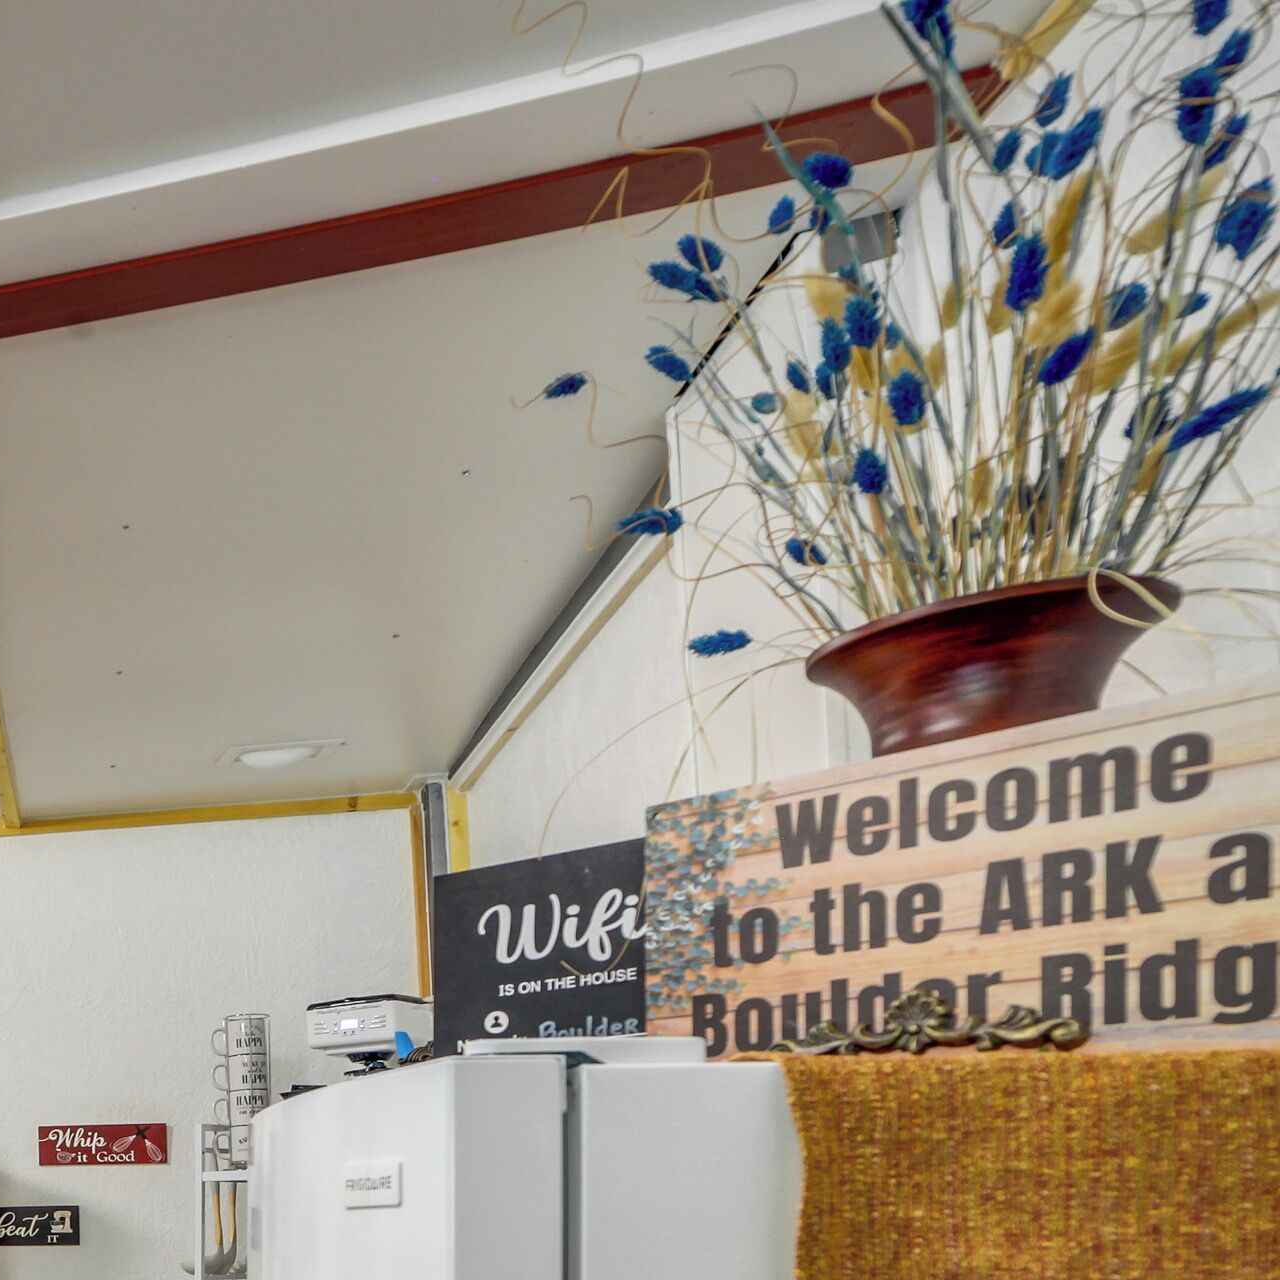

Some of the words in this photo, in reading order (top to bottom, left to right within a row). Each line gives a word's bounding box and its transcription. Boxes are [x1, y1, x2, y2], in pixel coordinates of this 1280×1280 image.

[775, 731, 1214, 869] Welcome
[710, 896, 779, 968] to
[810, 882, 943, 956] the
[979, 834, 1165, 935] ARK
[477, 888, 649, 964] Wifi
[498, 983, 515, 997] IS
[517, 979, 542, 994] ON
[544, 974, 577, 991] THE
[579, 967, 638, 987] HOUSE
[1041, 937, 1278, 1036] Ridg
[236, 1095, 264, 1106] HAPPY
[43, 1127, 107, 1154] Whip
[77, 1151, 88, 1162] it
[96, 1150, 135, 1163] Good
[47, 1234, 60, 1244] IT
